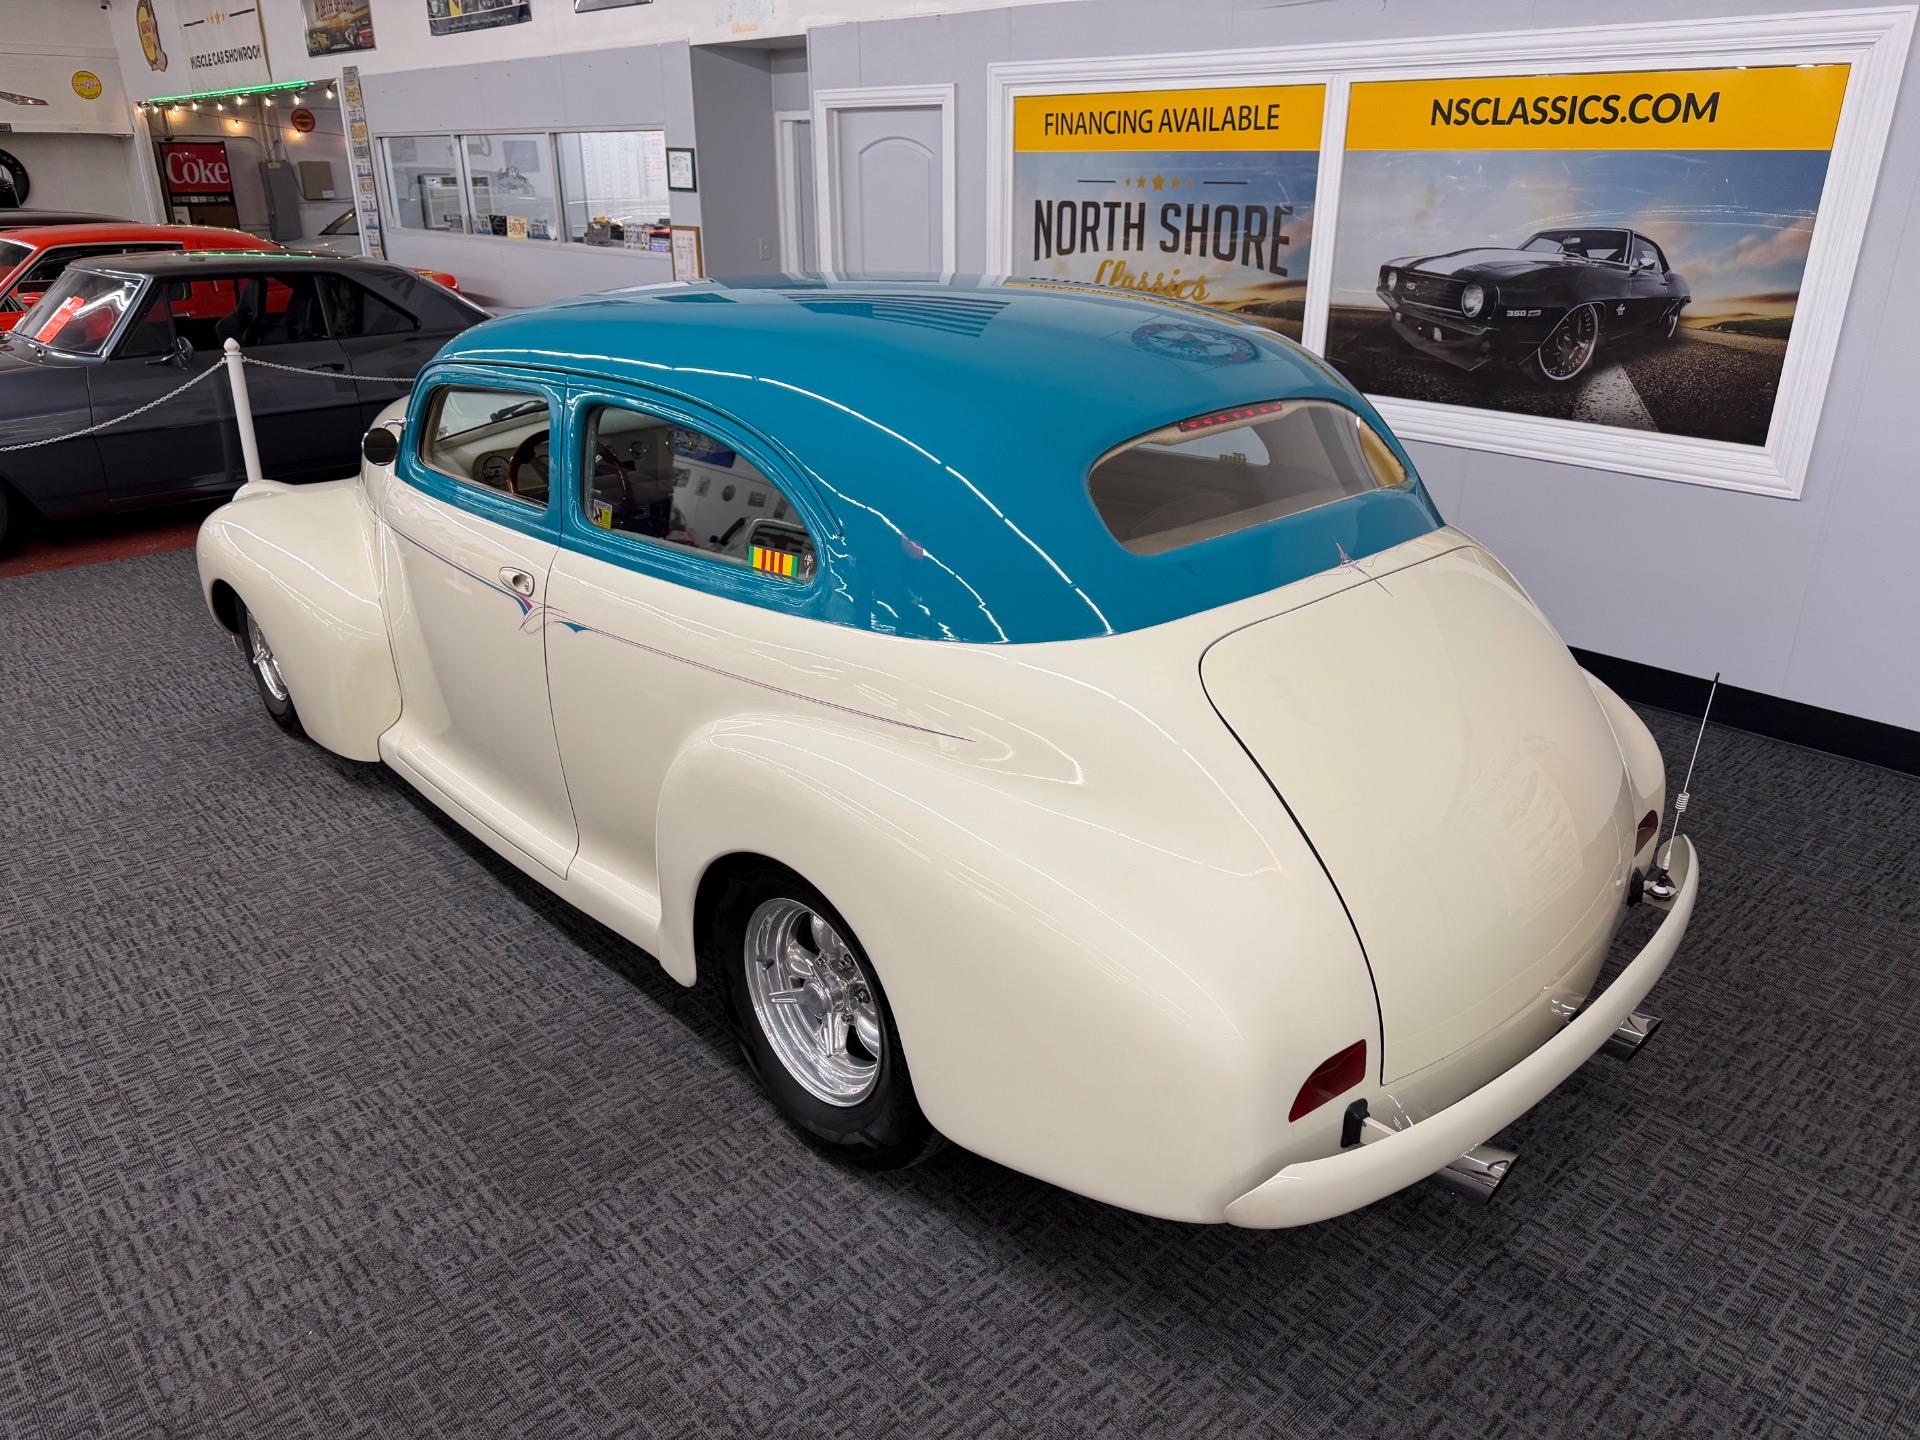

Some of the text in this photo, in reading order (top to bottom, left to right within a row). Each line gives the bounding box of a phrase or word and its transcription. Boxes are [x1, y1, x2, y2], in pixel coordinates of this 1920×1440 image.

[190, 43, 262, 69] MUSCLE CAR SHOWROOM
[1044, 104, 1281, 136] FINANCING AVAILABLE
[1431, 91, 1720, 126] NSCLASSICS.COM
[166, 152, 230, 184] Coke
[1033, 199, 1294, 278] NORTH SHORE
[1094, 259, 1210, 301] Classics
[1506, 309, 1527, 317] 350
